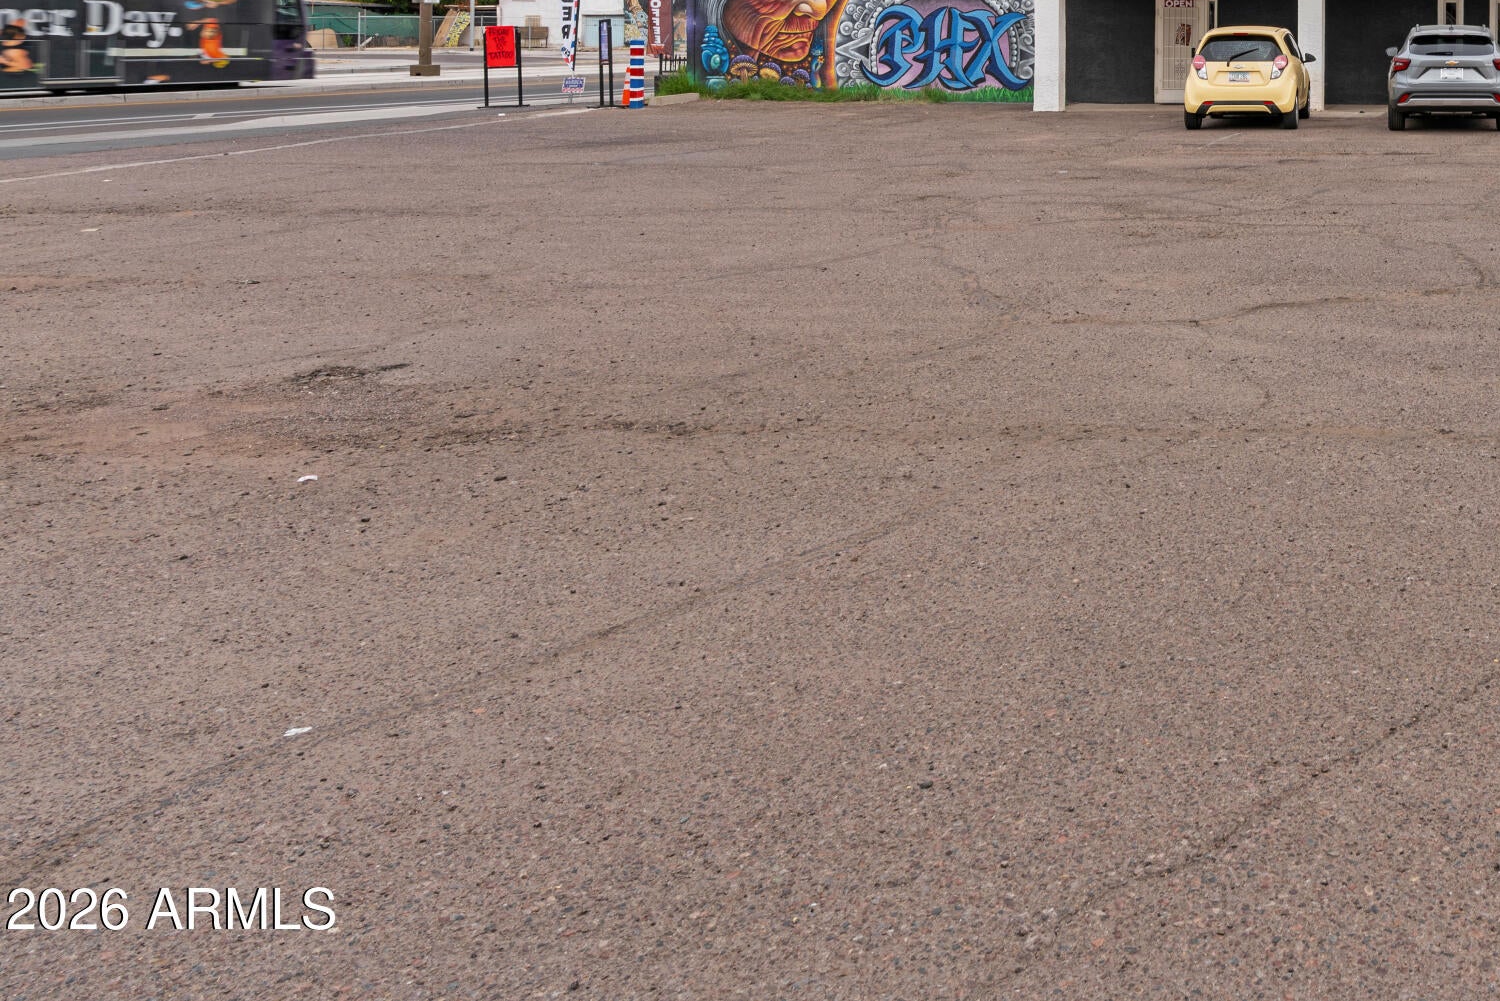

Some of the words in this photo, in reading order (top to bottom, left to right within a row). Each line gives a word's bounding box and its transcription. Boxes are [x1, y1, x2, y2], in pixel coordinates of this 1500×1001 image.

[83, 0, 183, 48] Day.
[1165, 0, 1194, 8] OPEN
[859, 4, 1034, 92] PHX
